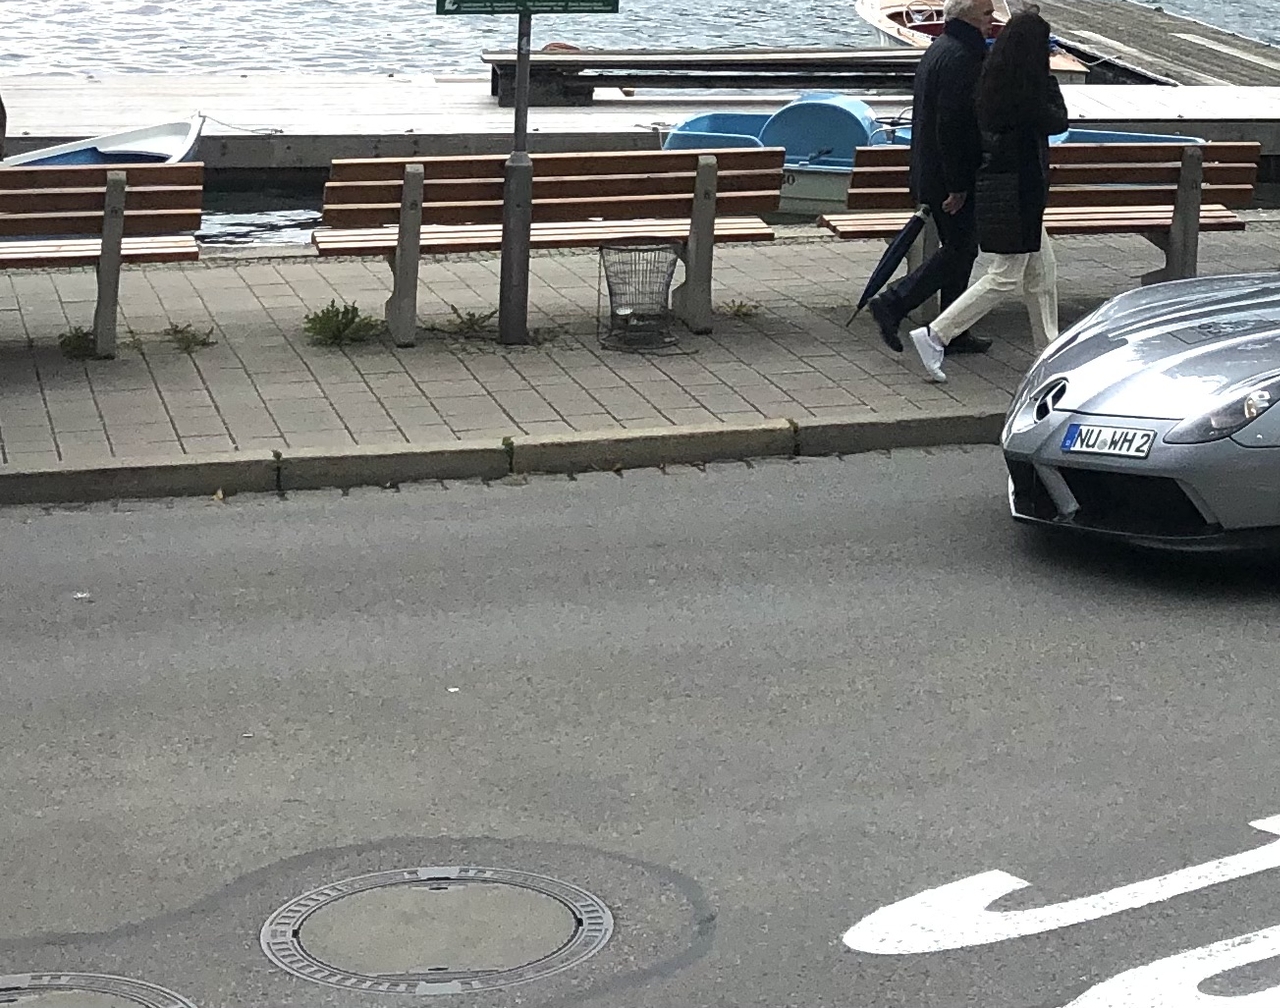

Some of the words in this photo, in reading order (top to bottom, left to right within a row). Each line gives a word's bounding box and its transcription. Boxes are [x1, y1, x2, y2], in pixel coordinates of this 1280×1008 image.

[1072, 429, 1102, 449] NU
[1107, 430, 1138, 452] WH
[1134, 433, 1151, 453] 2
